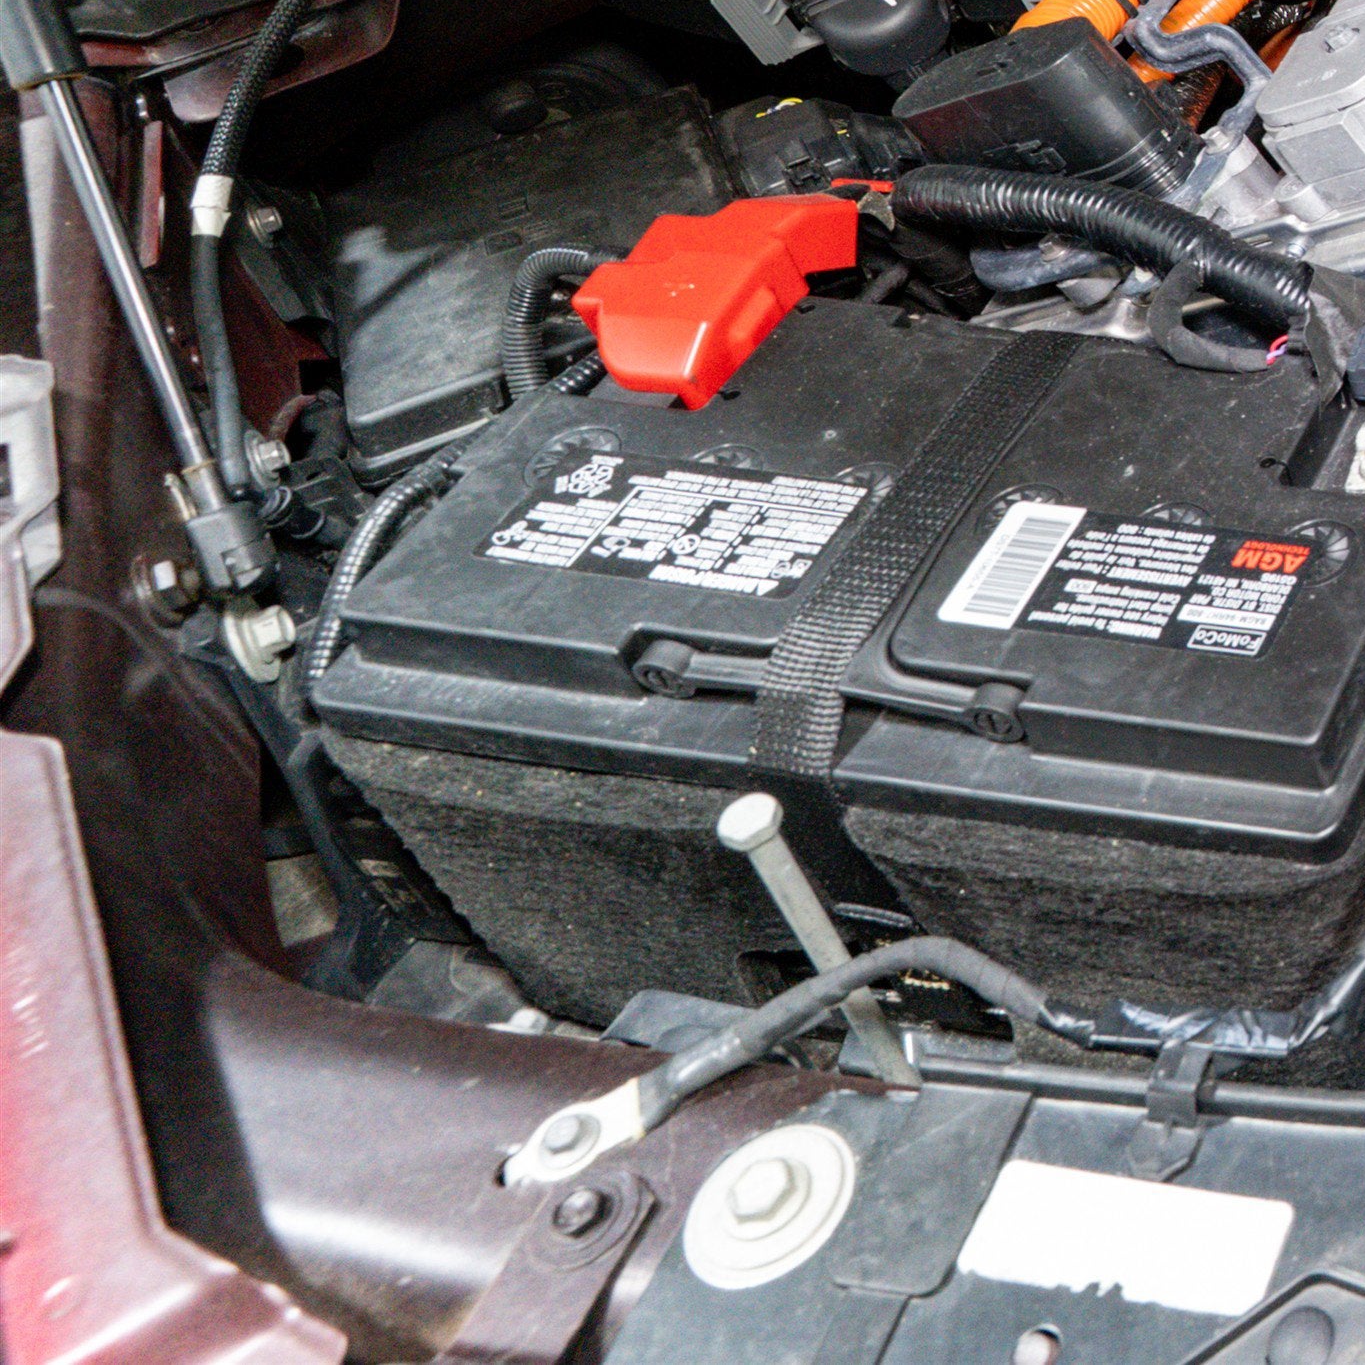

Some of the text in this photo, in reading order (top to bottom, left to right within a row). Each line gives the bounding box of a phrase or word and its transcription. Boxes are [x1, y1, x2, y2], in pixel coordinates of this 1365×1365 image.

[1241, 538, 1310, 555] TECHNOLOGY
[1230, 548, 1307, 574] AGM
[1226, 587, 1259, 599] MOTOR
[1260, 592, 1286, 604] FORD
[1193, 627, 1261, 649] FoMoCo
